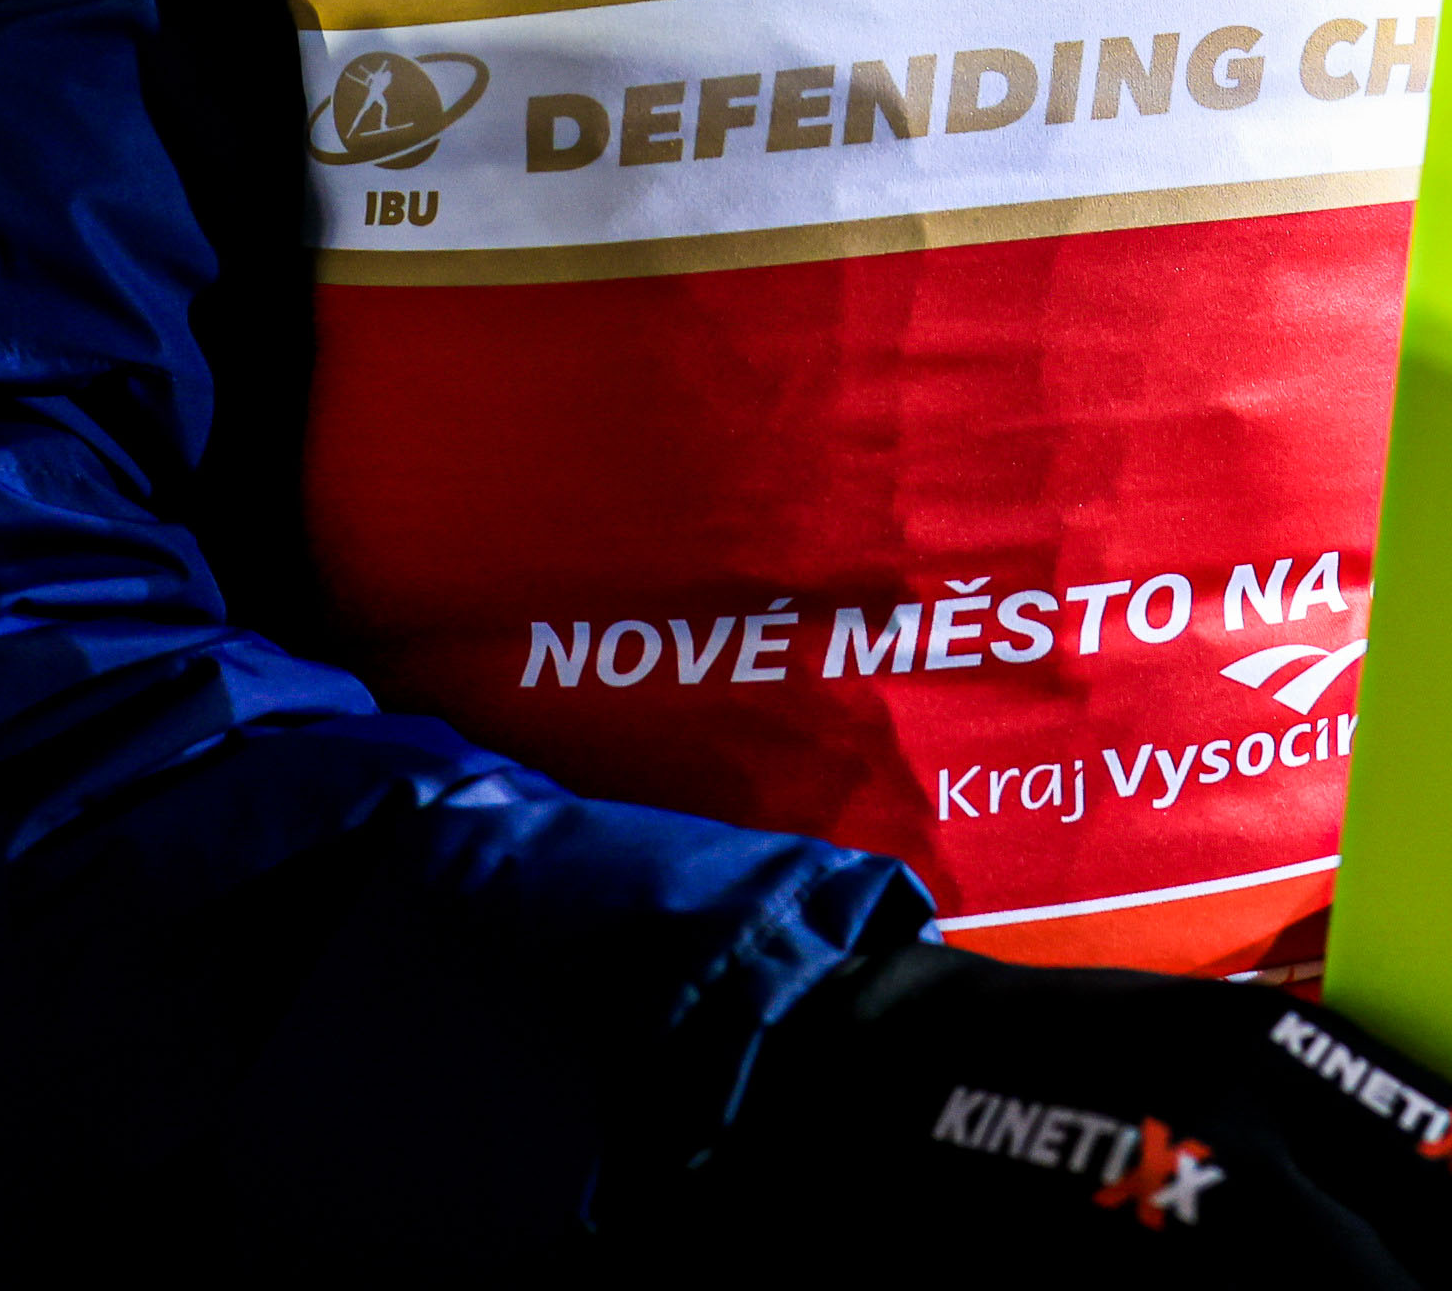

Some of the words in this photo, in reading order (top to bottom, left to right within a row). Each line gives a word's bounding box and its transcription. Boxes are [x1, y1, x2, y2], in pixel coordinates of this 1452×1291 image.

[525, 24, 1266, 175] DEFENDING
[1299, 16, 1437, 102] CH
[365, 189, 440, 227] IBU
[520, 597, 799, 688] NOVÉ
[822, 575, 1193, 680] MĚSTO
[1224, 551, 1349, 631] NA
[937, 757, 1087, 823] Kraj
